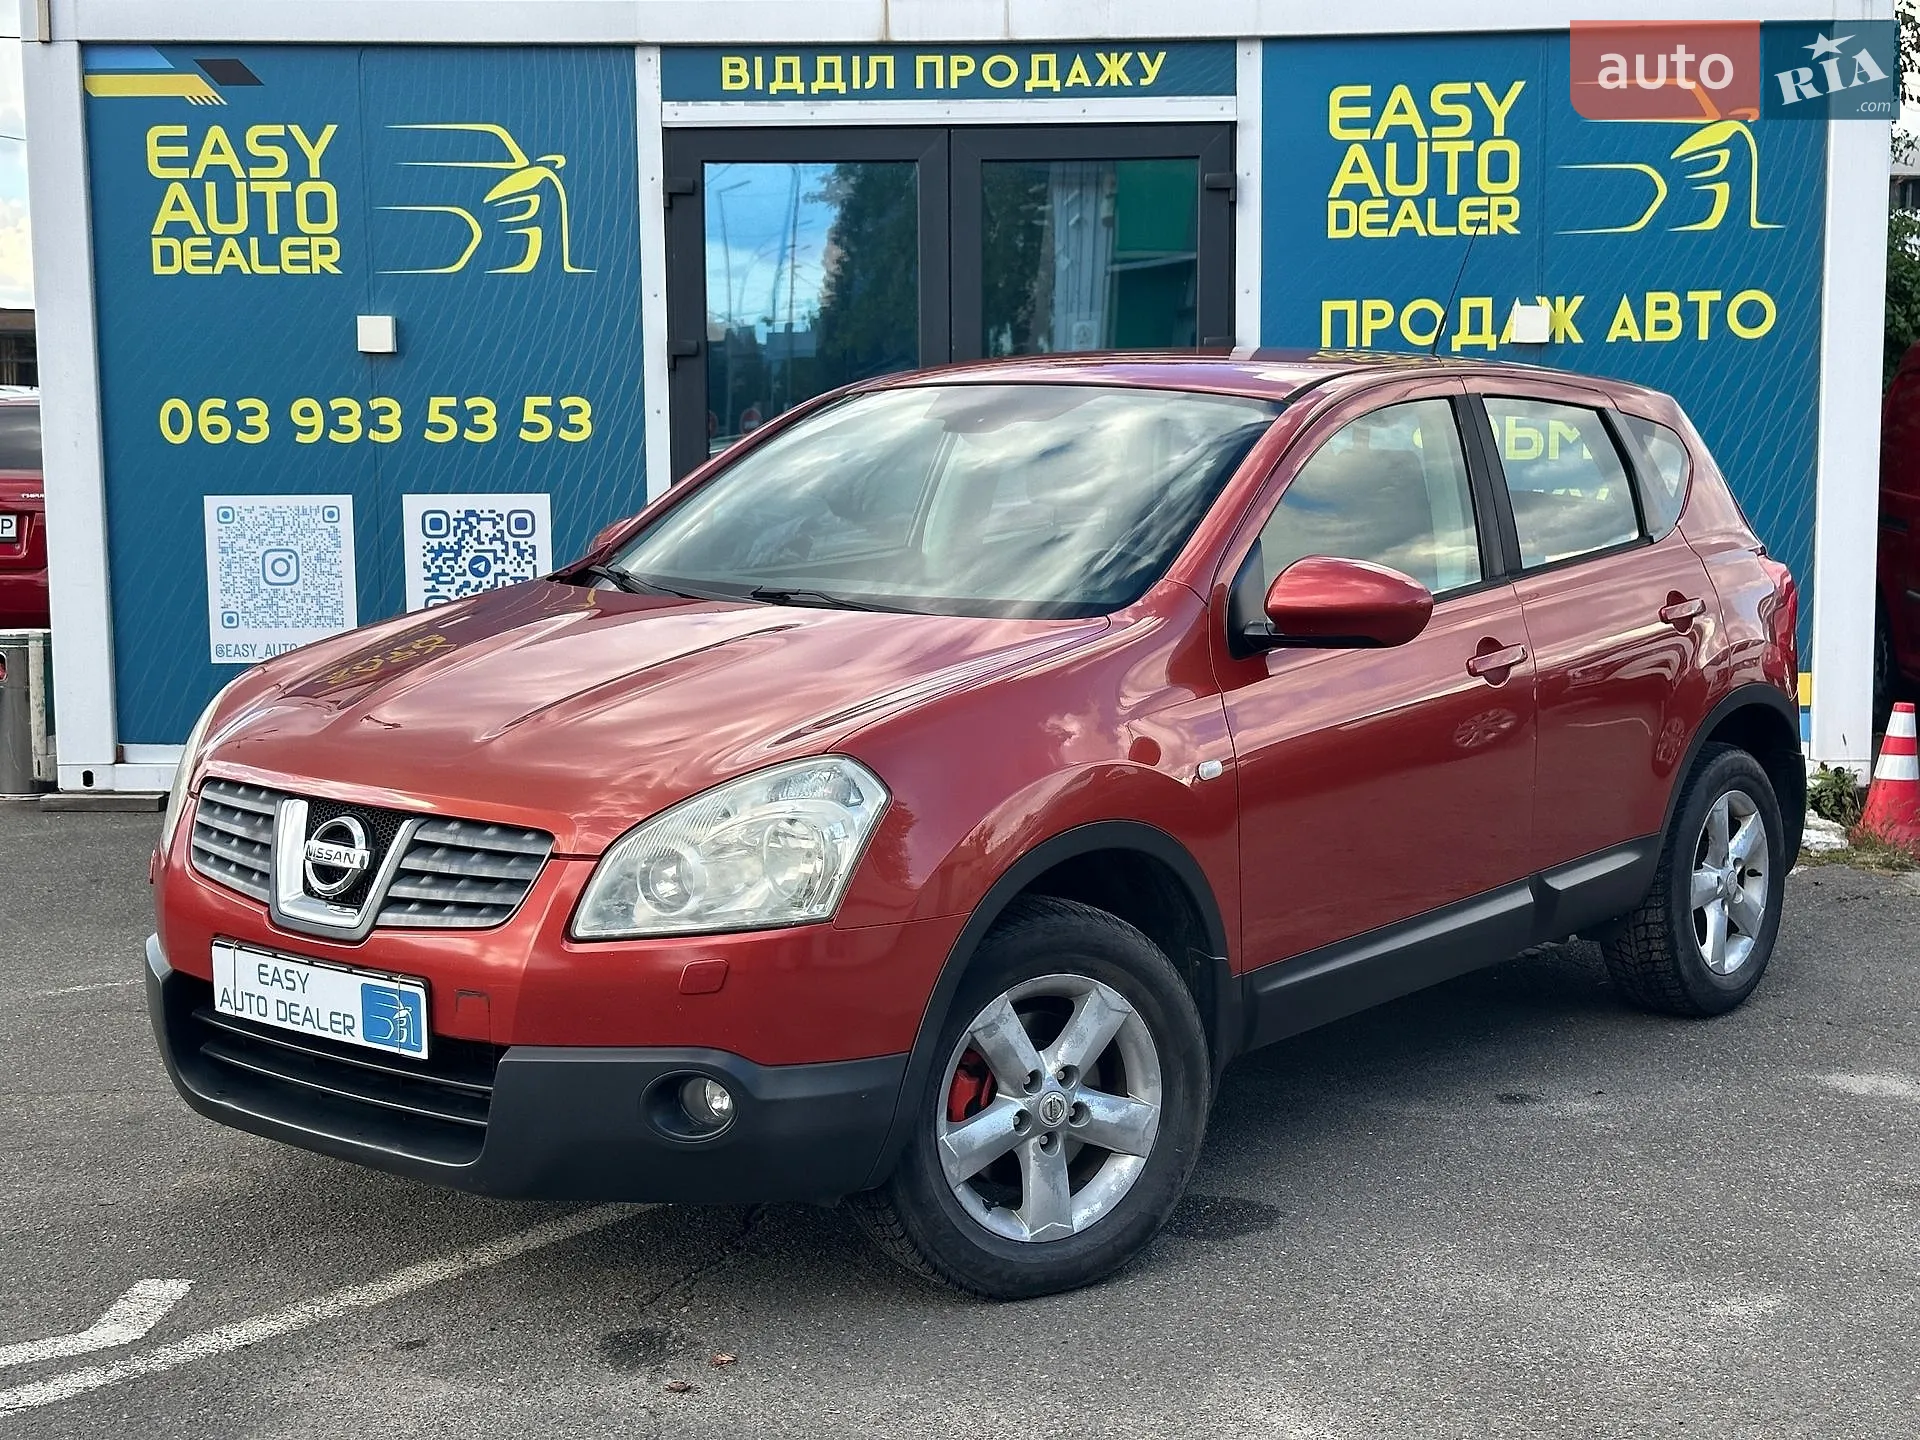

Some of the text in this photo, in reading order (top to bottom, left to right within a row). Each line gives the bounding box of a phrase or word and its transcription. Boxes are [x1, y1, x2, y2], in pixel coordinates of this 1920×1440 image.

[721, 52, 1167, 94] ВІДДІЛ ПРОДАЖУ
[1328, 81, 1526, 141] EASY
[146, 124, 338, 179] EASY
[1328, 139, 1521, 198] AUTO
[151, 180, 340, 235] AUTO
[1327, 195, 1521, 239] DEALER
[150, 236, 343, 275] DEALER
[1606, 289, 1777, 343] АВТО
[159, 396, 593, 444] 063 933 53 53
[306, 844, 356, 865] NISSAN
[257, 963, 310, 994] EASY
[219, 987, 356, 1038] AUTO DEALER
